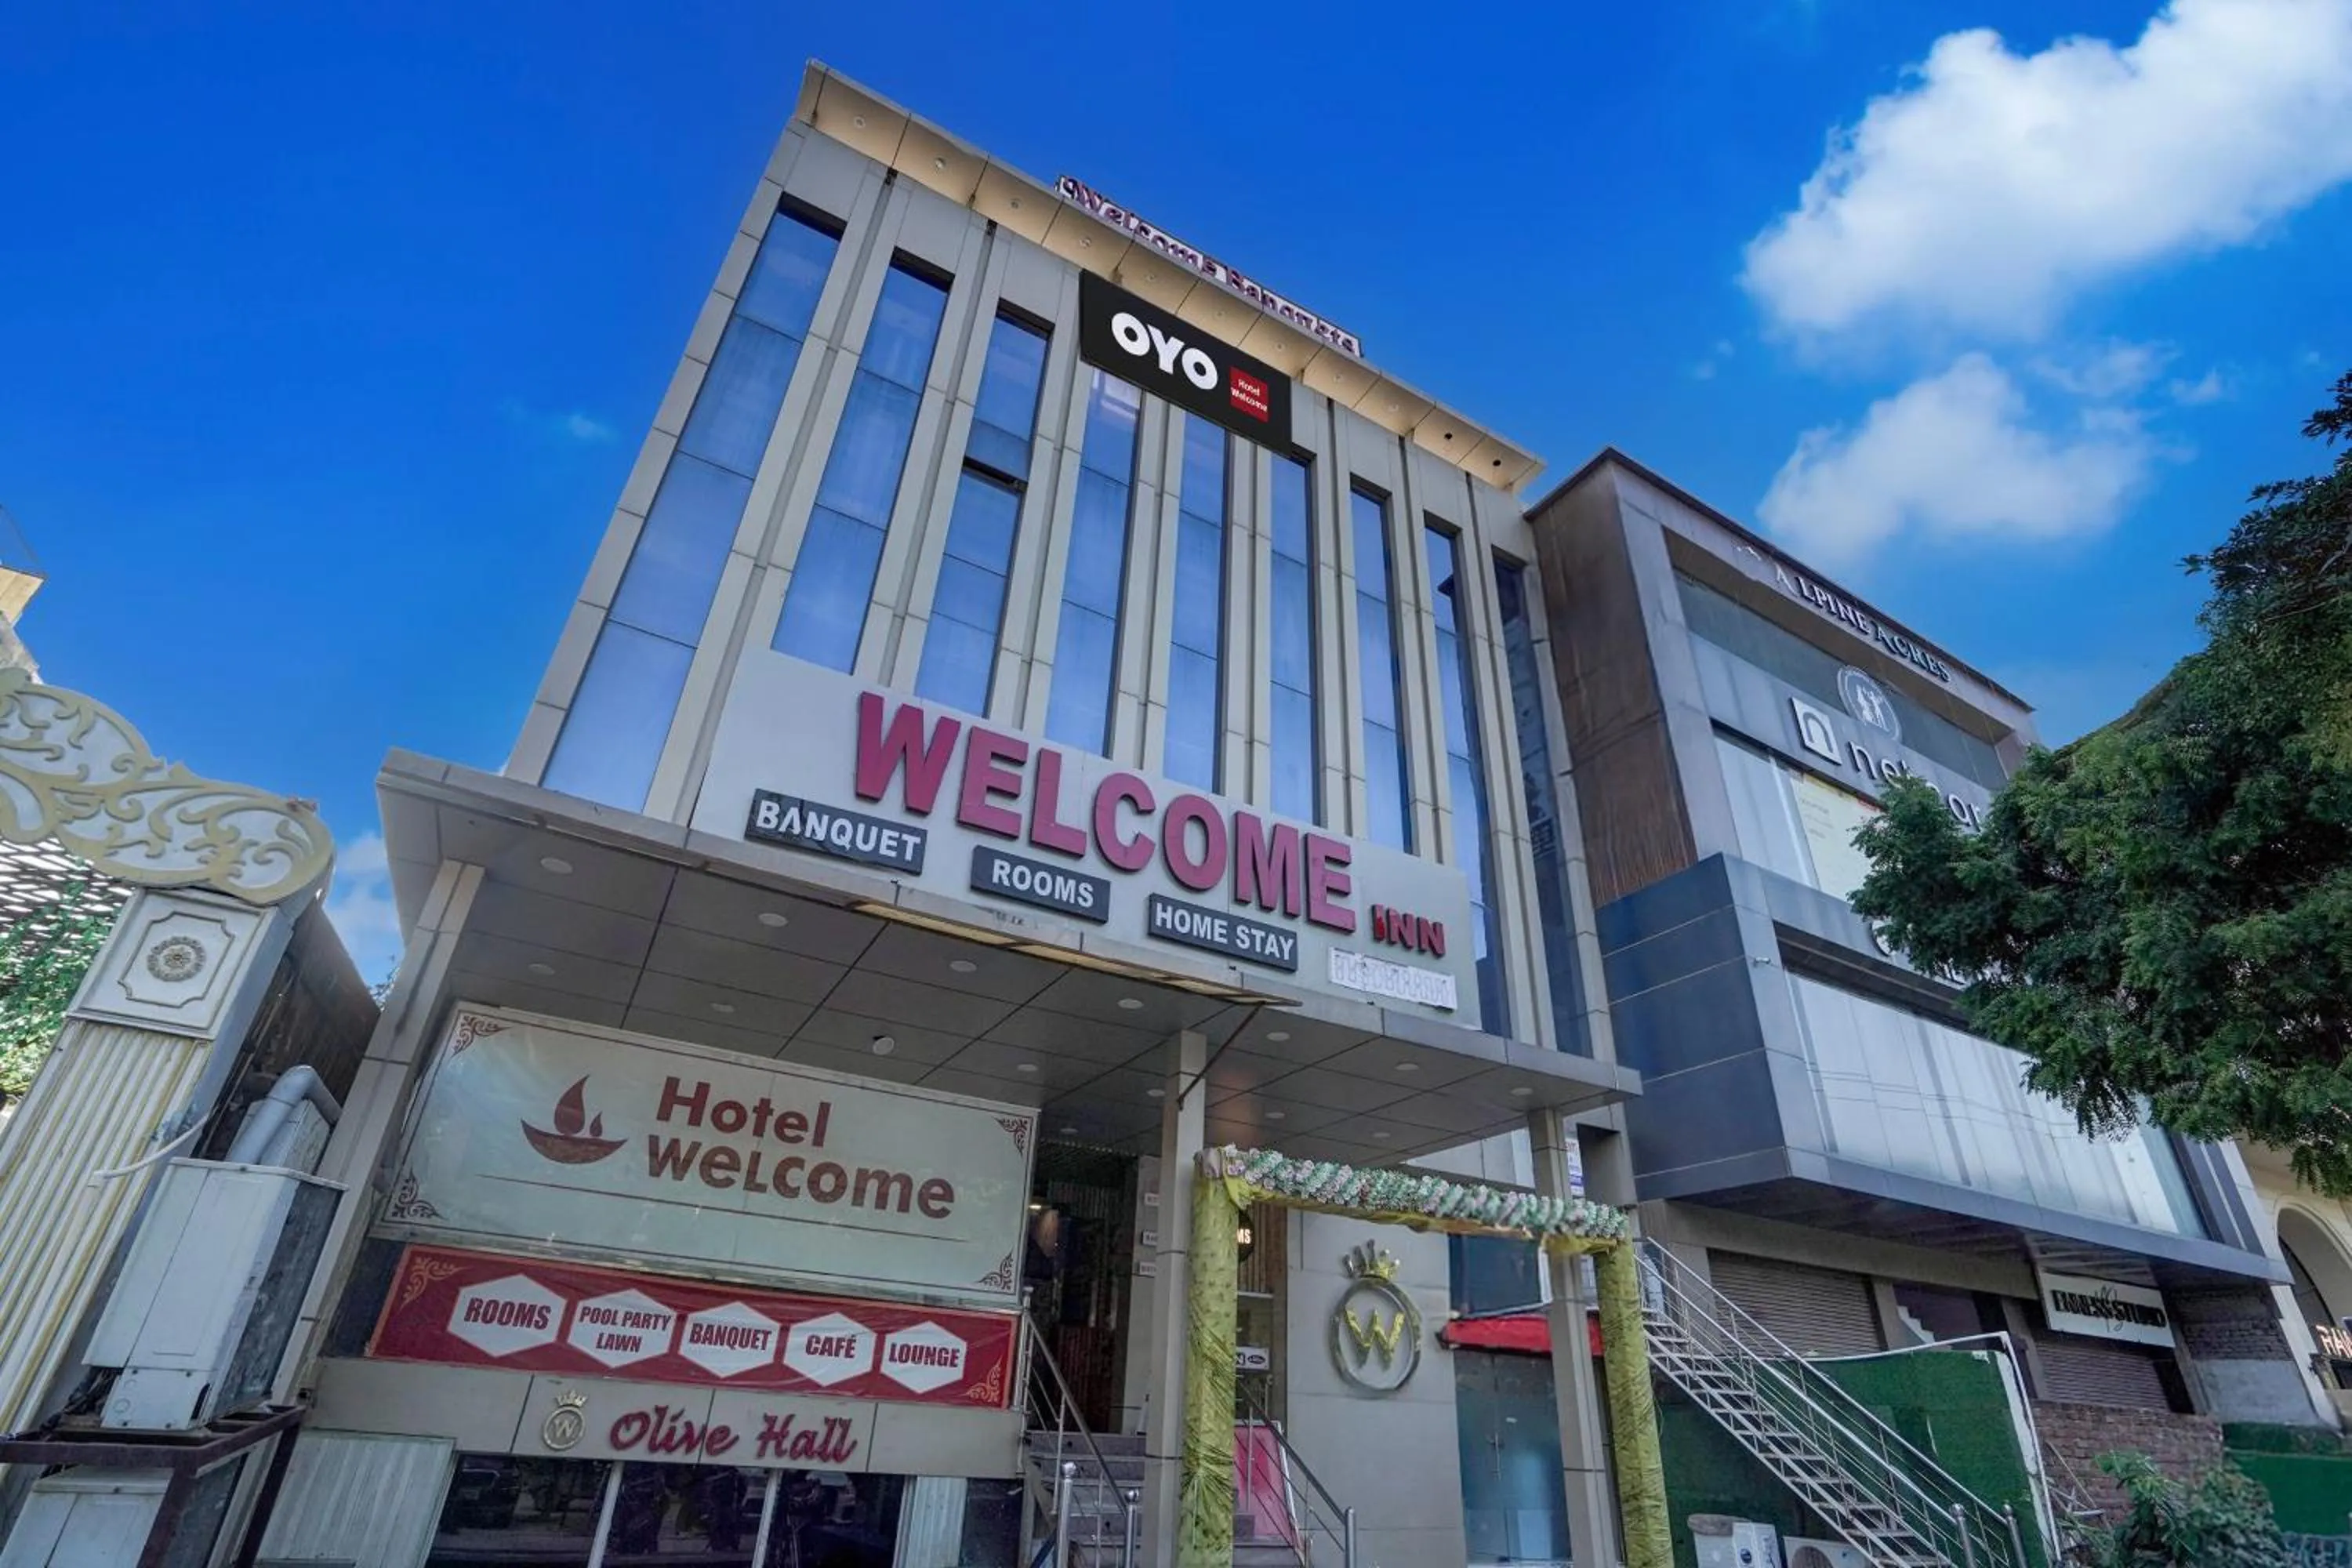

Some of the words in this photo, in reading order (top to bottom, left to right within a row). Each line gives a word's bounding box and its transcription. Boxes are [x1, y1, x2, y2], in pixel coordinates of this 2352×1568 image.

[1111, 312, 1218, 390] OYO
[754, 799, 921, 862] BANQUET
[855, 690, 1356, 933] WELCOME
[1372, 902, 1446, 958] INN
[991, 858, 1094, 909] ROOMS
[1154, 902, 1228, 944] HOME
[1234, 926, 1294, 962] STAY
[655, 1076, 831, 1149] Hotel
[463, 1296, 552, 1330] ROOMS
[579, 1305, 621, 1325] POOL
[622, 1310, 671, 1332] PARTY
[688, 1323, 773, 1351] BANQUET
[595, 1332, 643, 1353] LAWN
[805, 1334, 858, 1359] CAFÉ
[888, 1342, 961, 1368] LOUNGE
[610, 1405, 739, 1454] Olive
[755, 1413, 858, 1464] Hall
